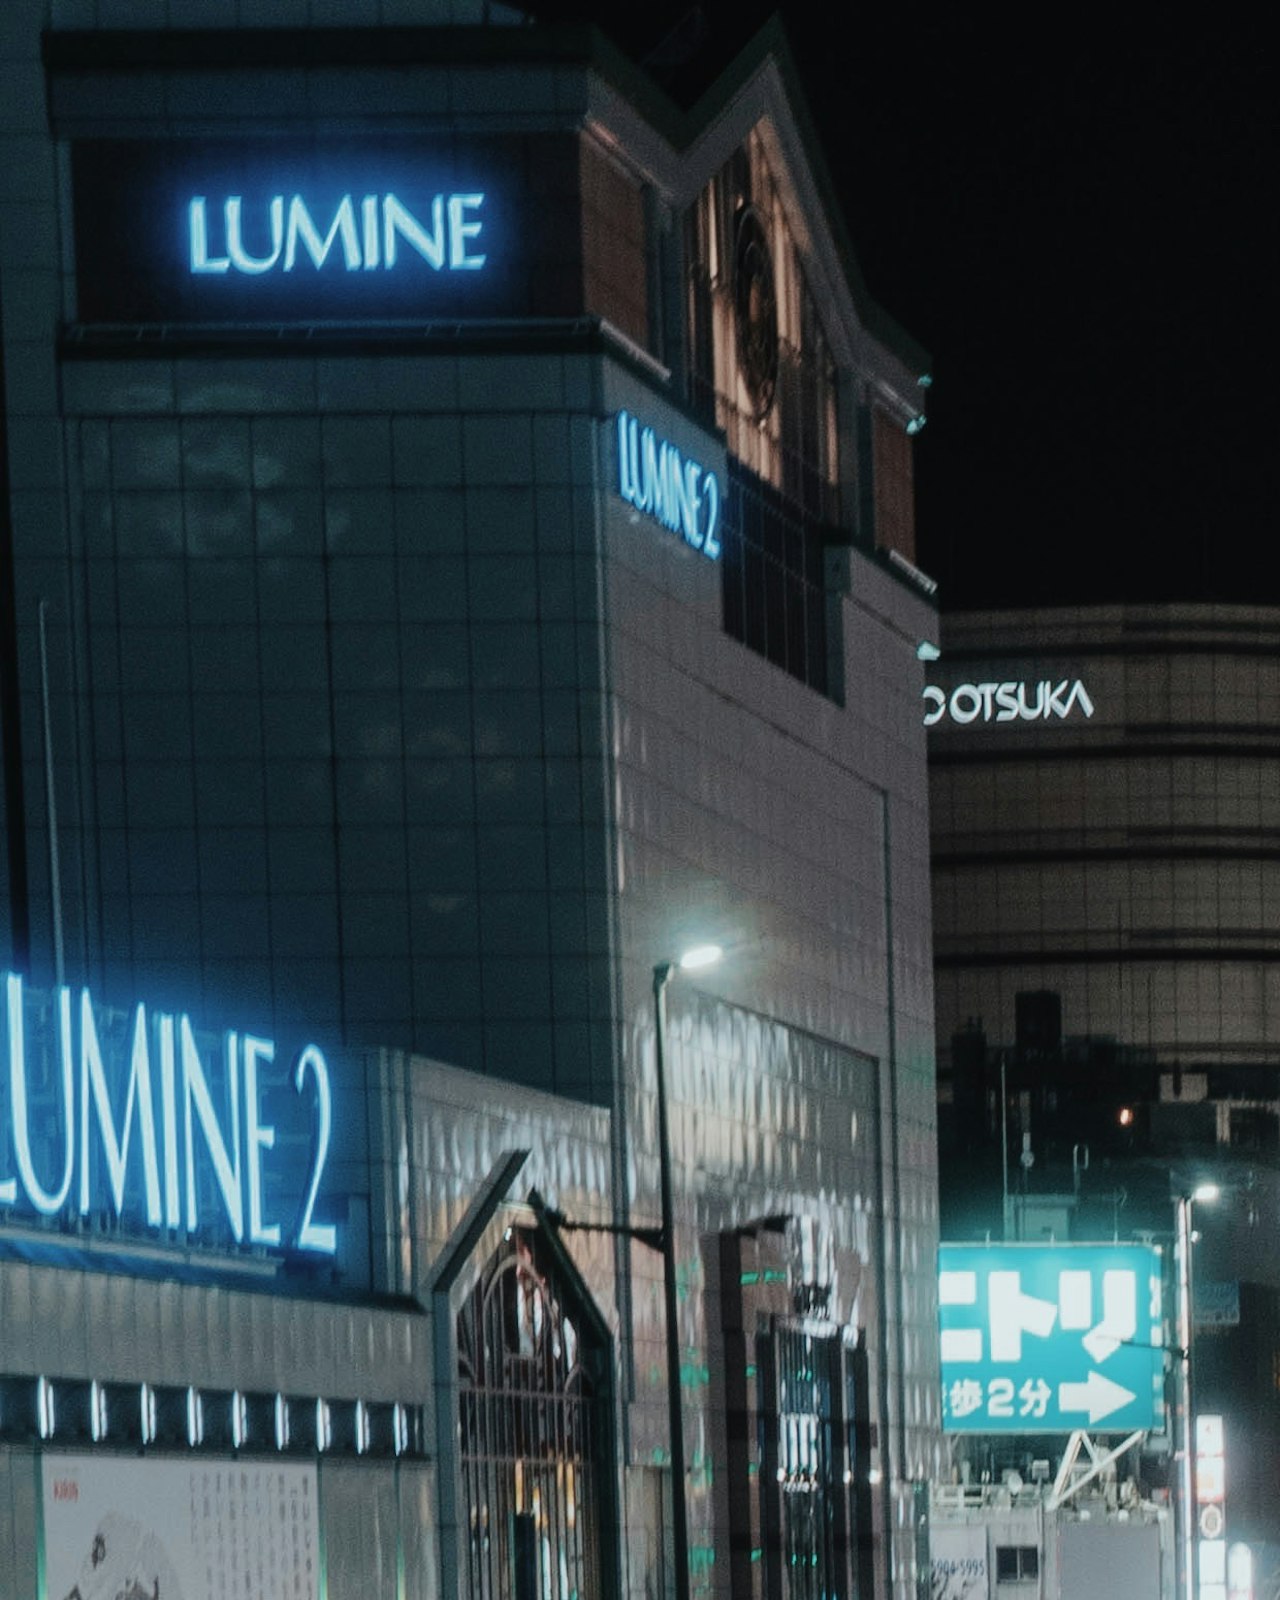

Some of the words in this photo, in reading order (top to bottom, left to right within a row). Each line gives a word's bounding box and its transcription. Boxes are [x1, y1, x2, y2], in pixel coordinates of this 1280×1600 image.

[188, 193, 487, 274] LUMINE
[617, 410, 705, 552] LUMINE
[704, 474, 721, 560] 2
[948, 678, 1095, 725] OTSUKA
[0, 971, 283, 1246] UMINE
[295, 1043, 338, 1254] 2
[938, 1270, 1137, 1363] ニトリ
